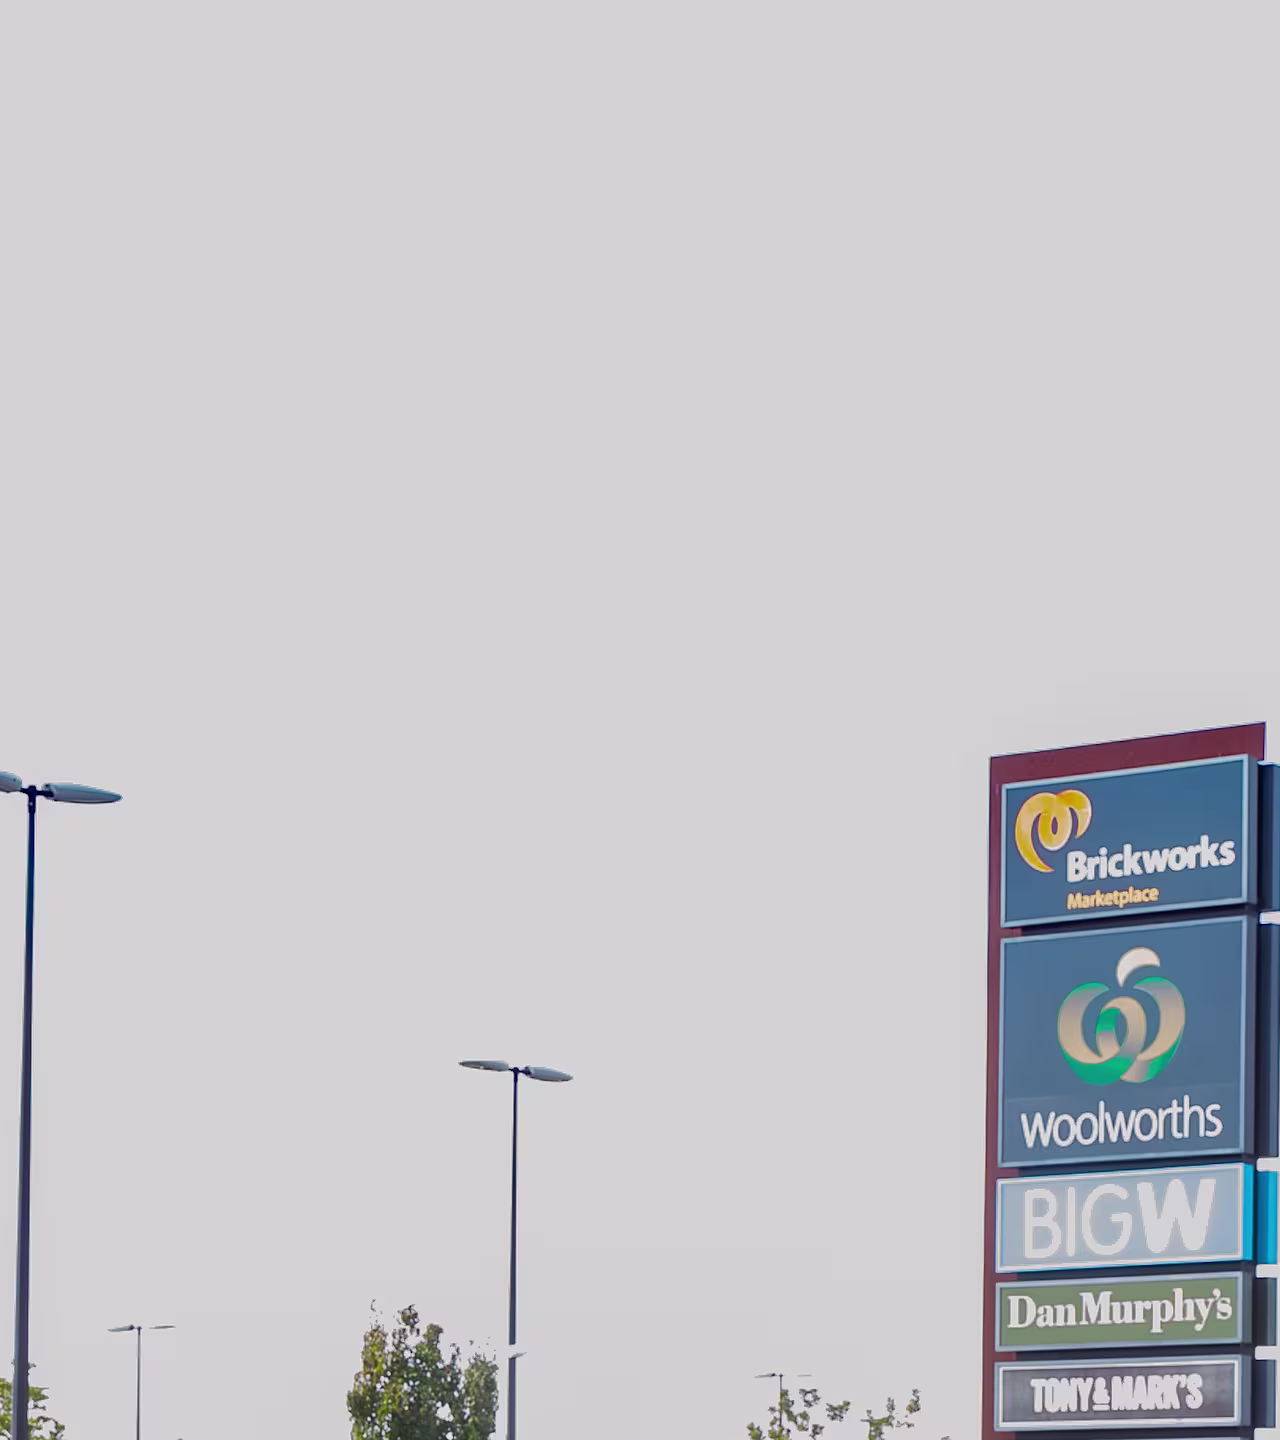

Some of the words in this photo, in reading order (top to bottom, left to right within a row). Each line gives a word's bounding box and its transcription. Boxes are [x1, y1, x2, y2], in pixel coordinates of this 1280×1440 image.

[1067, 835, 1236, 883] Brickworks
[1067, 886, 1159, 910] Marketplace
[1021, 1095, 1223, 1148] Woolworths
[1007, 1295, 1076, 1328] Dan
[1079, 1288, 1232, 1333] Murphy's
